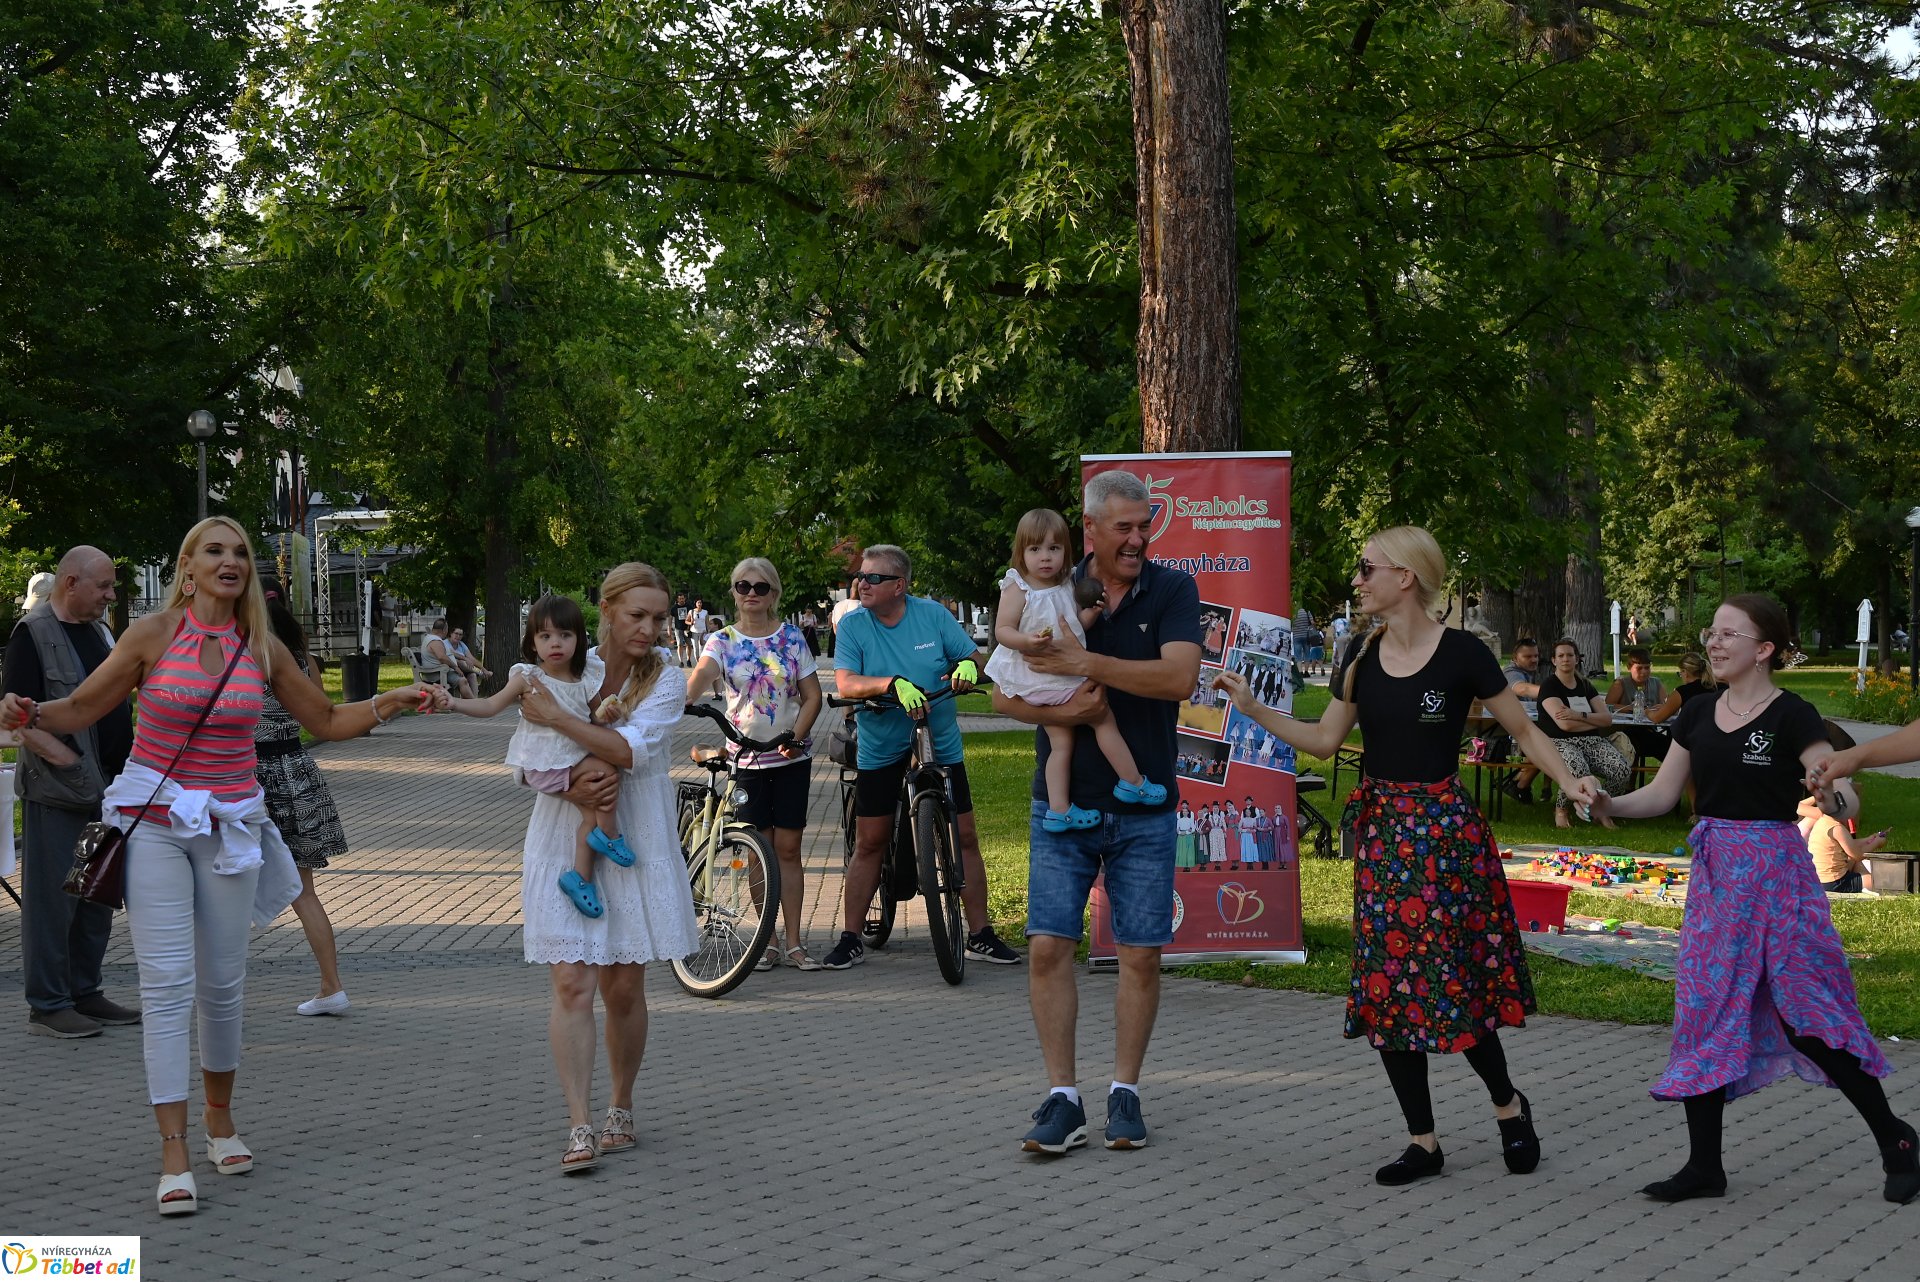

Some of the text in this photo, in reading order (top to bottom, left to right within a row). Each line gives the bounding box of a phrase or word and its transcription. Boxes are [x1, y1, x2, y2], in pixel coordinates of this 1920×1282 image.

[1175, 495, 1268, 517] Szabolcs
[1192, 517, 1281, 532] Néptáncegyüttes
[1742, 752, 1771, 762] Szabolcs
[1207, 930, 1269, 939] NYÍREGYHÁZA
